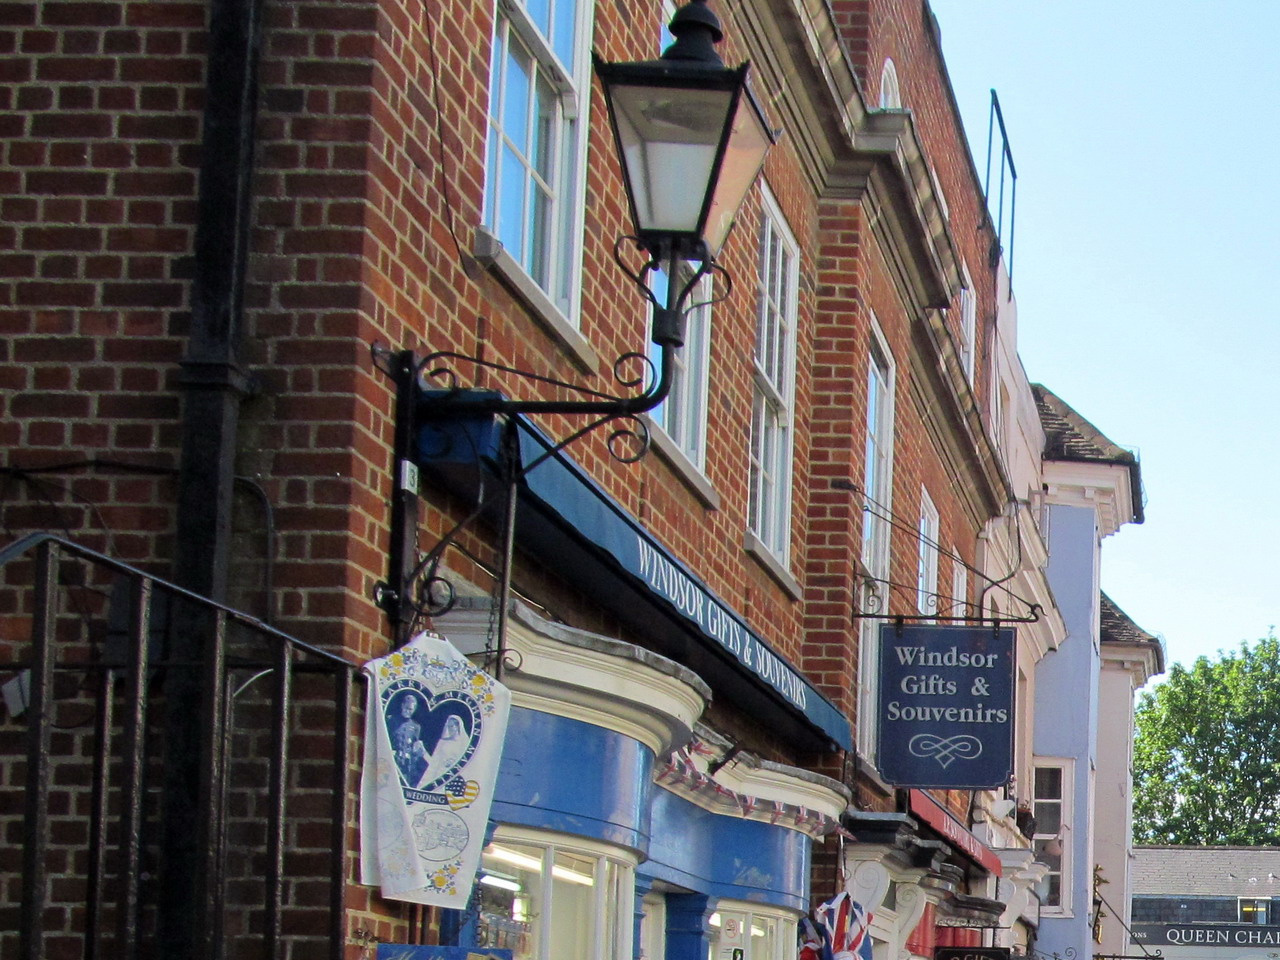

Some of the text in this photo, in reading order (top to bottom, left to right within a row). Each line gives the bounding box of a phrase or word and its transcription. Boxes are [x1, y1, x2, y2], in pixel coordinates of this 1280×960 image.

[637, 535, 807, 711] WINDSOR GIFTS & SOUVENIRS
[894, 646, 999, 668] Windsor
[900, 675, 991, 697] Gifts &
[887, 701, 1008, 724] Souvenirs
[406, 790, 446, 804] WEDDING
[1166, 928, 1231, 945] QUEEN
